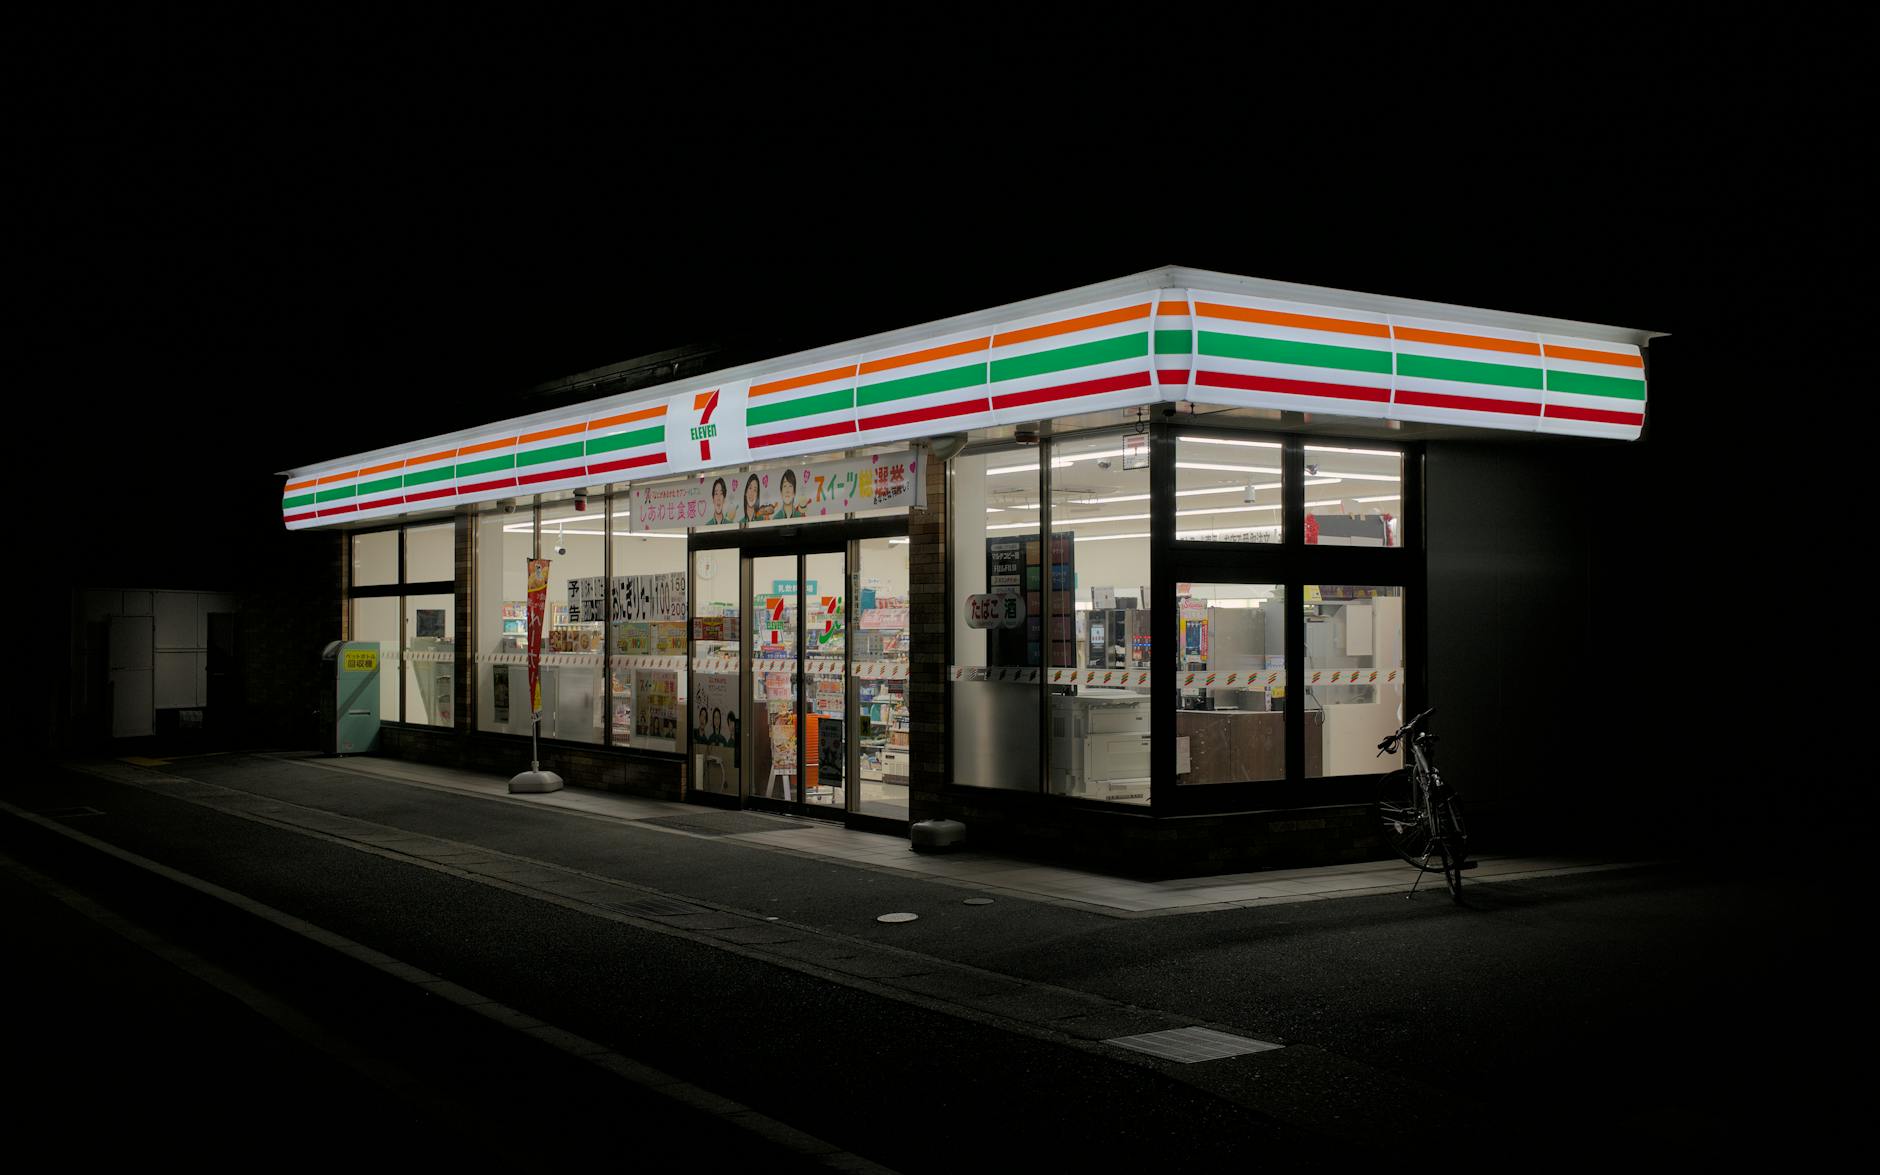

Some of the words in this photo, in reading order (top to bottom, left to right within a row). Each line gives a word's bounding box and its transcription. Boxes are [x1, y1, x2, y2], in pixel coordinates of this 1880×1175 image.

[693, 389, 720, 461] 7
[568, 581, 580, 622] 予告
[671, 602, 686, 616] 200
[971, 598, 999, 620] たばこ
[1004, 598, 1017, 619] 酒
